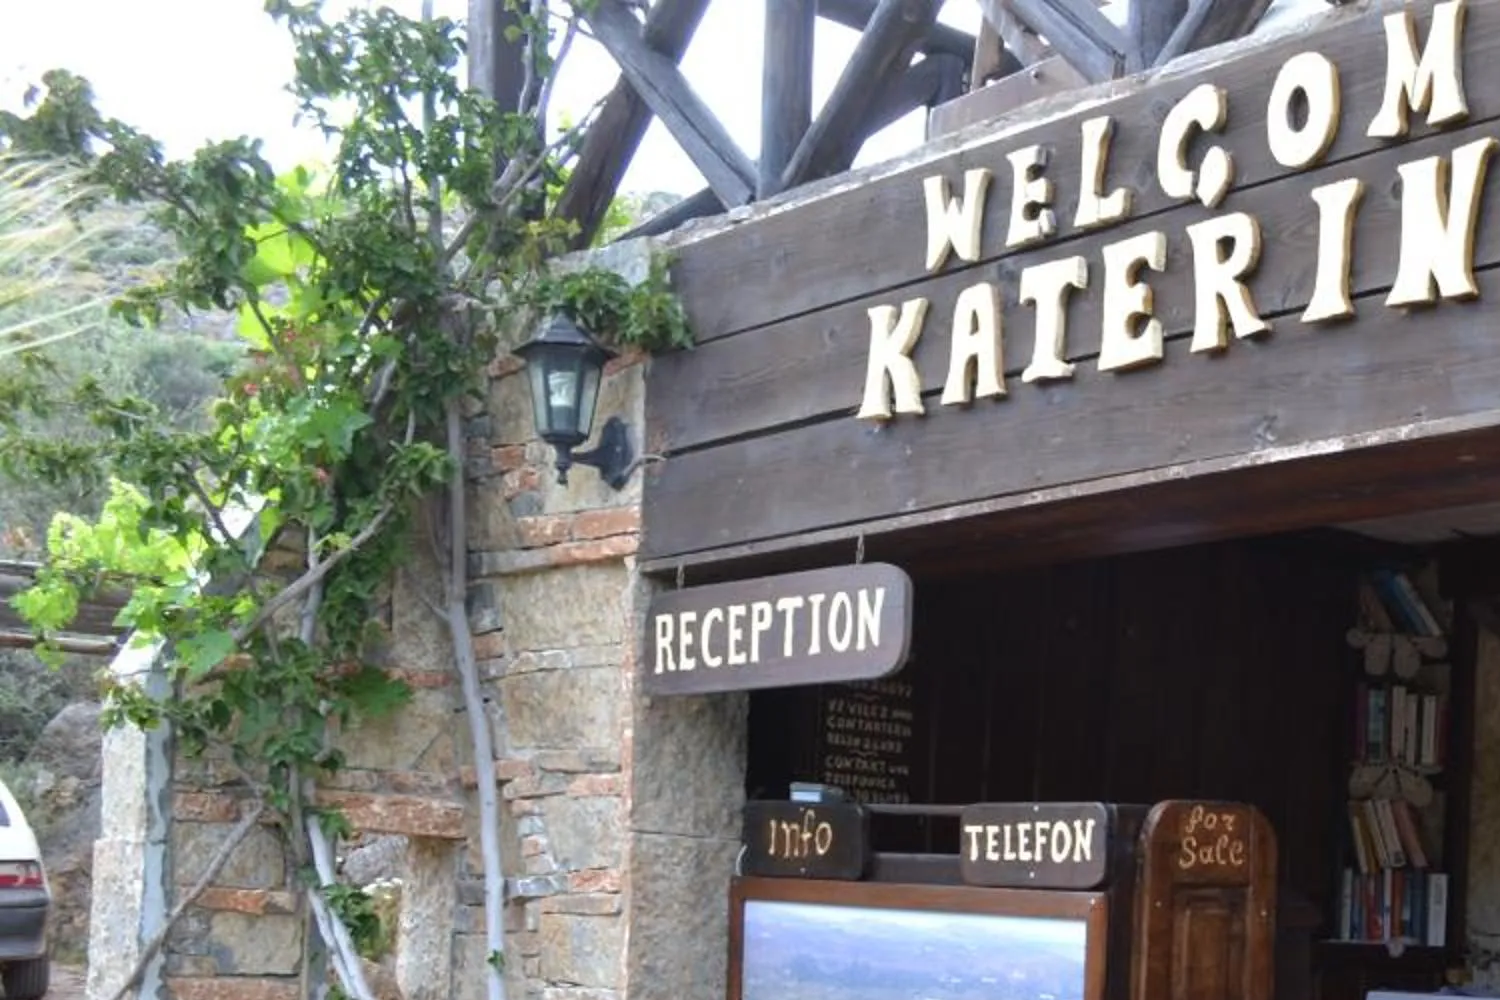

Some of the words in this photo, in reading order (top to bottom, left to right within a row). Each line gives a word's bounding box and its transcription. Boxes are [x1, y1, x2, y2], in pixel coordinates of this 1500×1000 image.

[654, 587, 885, 675] RECEPTION
[965, 819, 1096, 864] TELEFON
[1178, 835, 1246, 870] Sale
